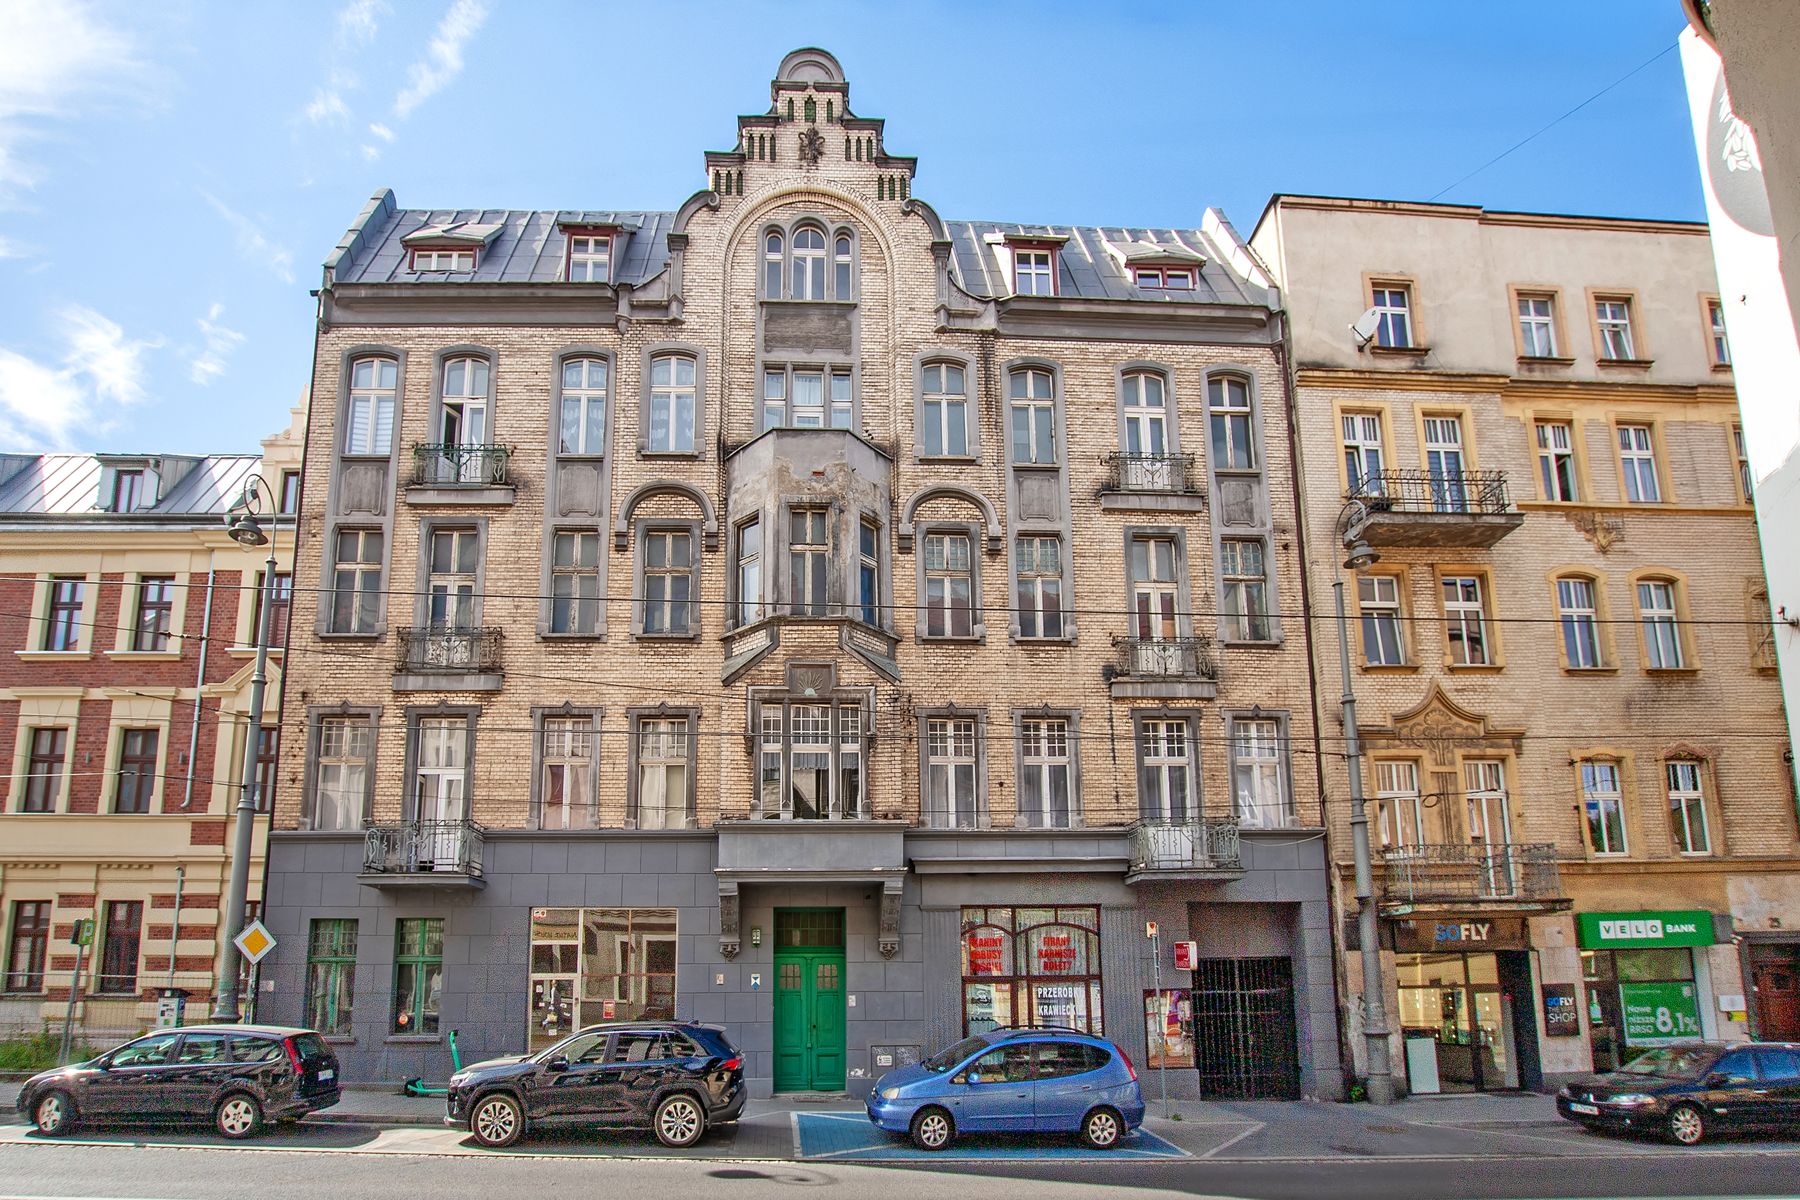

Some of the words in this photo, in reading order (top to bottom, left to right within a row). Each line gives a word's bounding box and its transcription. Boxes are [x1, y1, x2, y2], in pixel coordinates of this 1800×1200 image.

[83, 923, 93, 941] P
[1602, 924, 1660, 935] VELO
[1666, 924, 1696, 933] BANK
[1547, 997, 1574, 1006] SOFLY
[1549, 1012, 1577, 1023] SHOP
